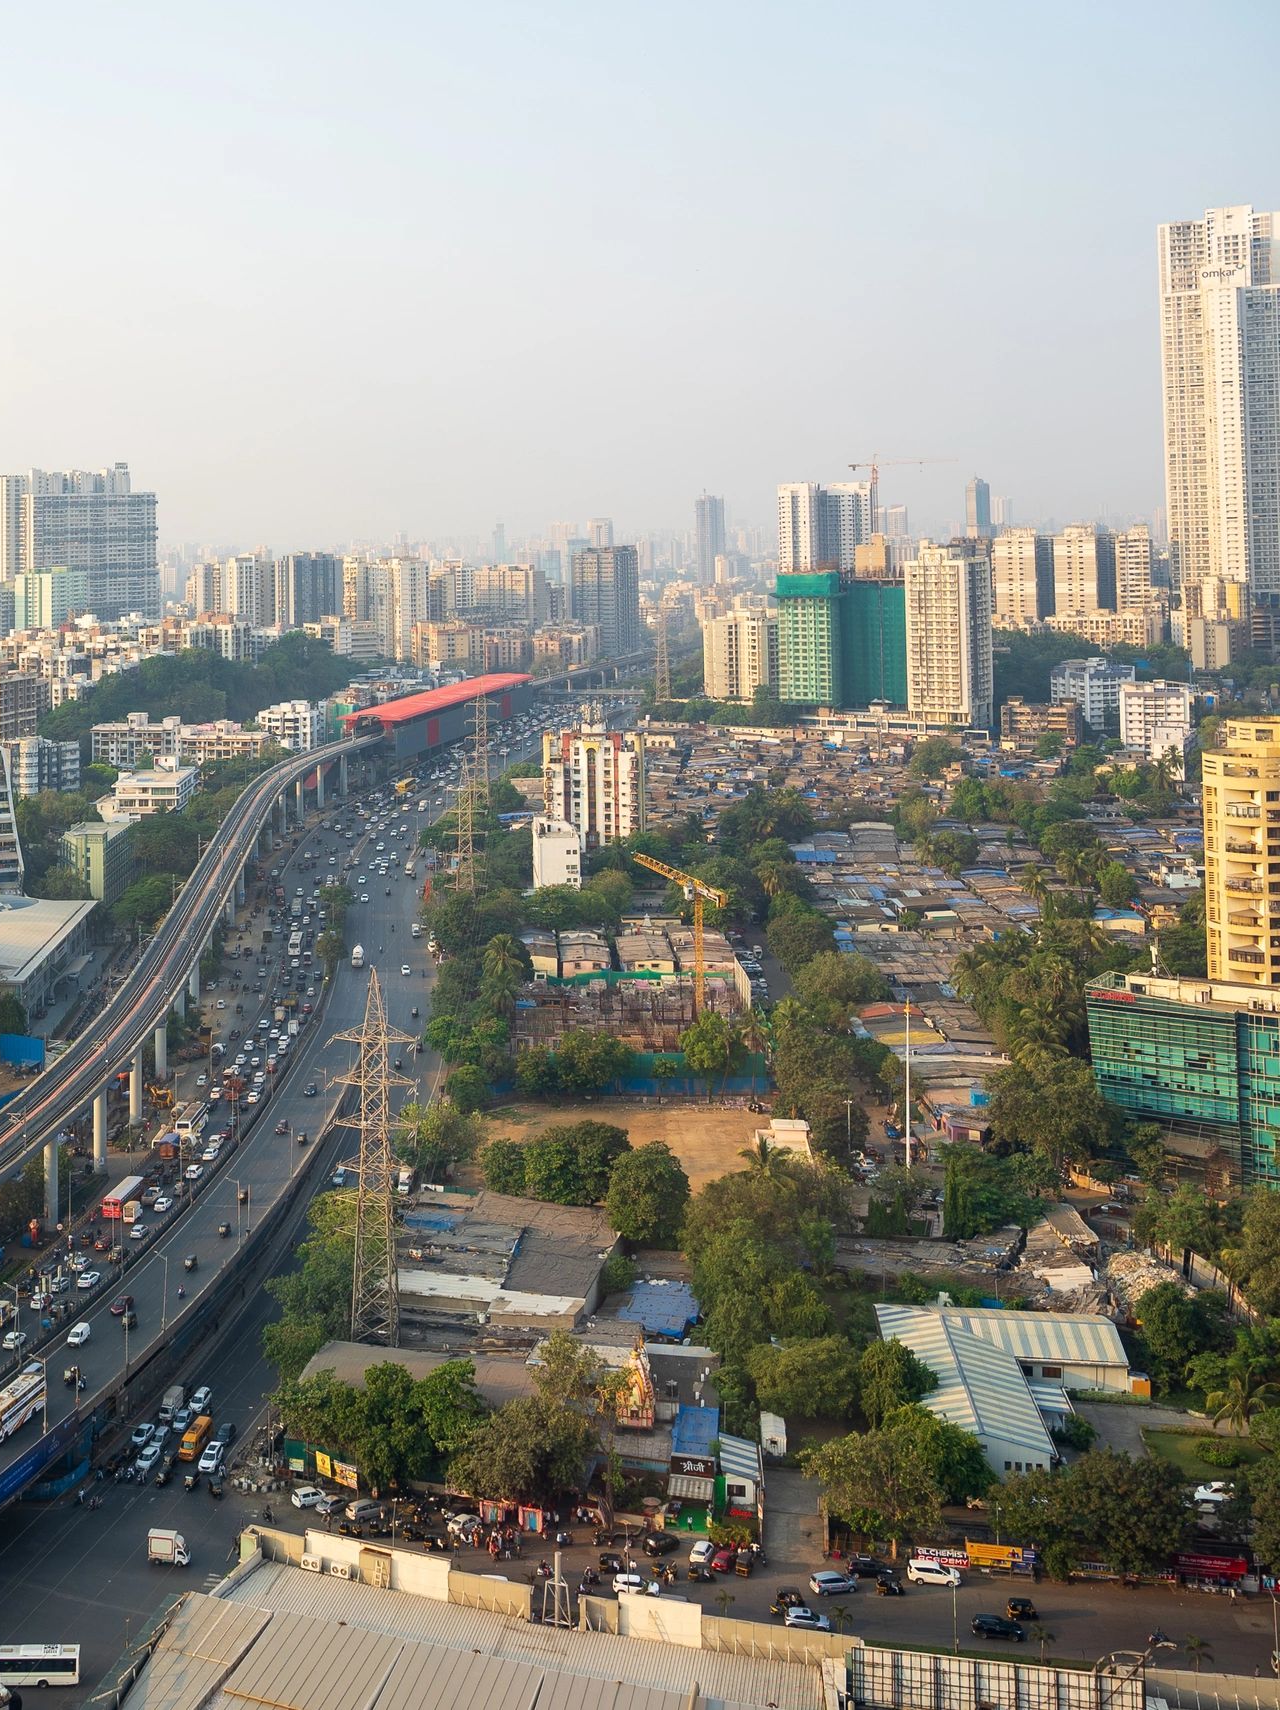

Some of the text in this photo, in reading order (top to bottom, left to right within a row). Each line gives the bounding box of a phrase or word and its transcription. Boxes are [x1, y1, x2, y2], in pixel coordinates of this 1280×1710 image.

[1202, 268, 1237, 278] omkar
[682, 1460, 705, 1473] श्रीजी
[917, 1548, 968, 1559] ALCHEMIST
[917, 1555, 968, 1566] ACADEMY
